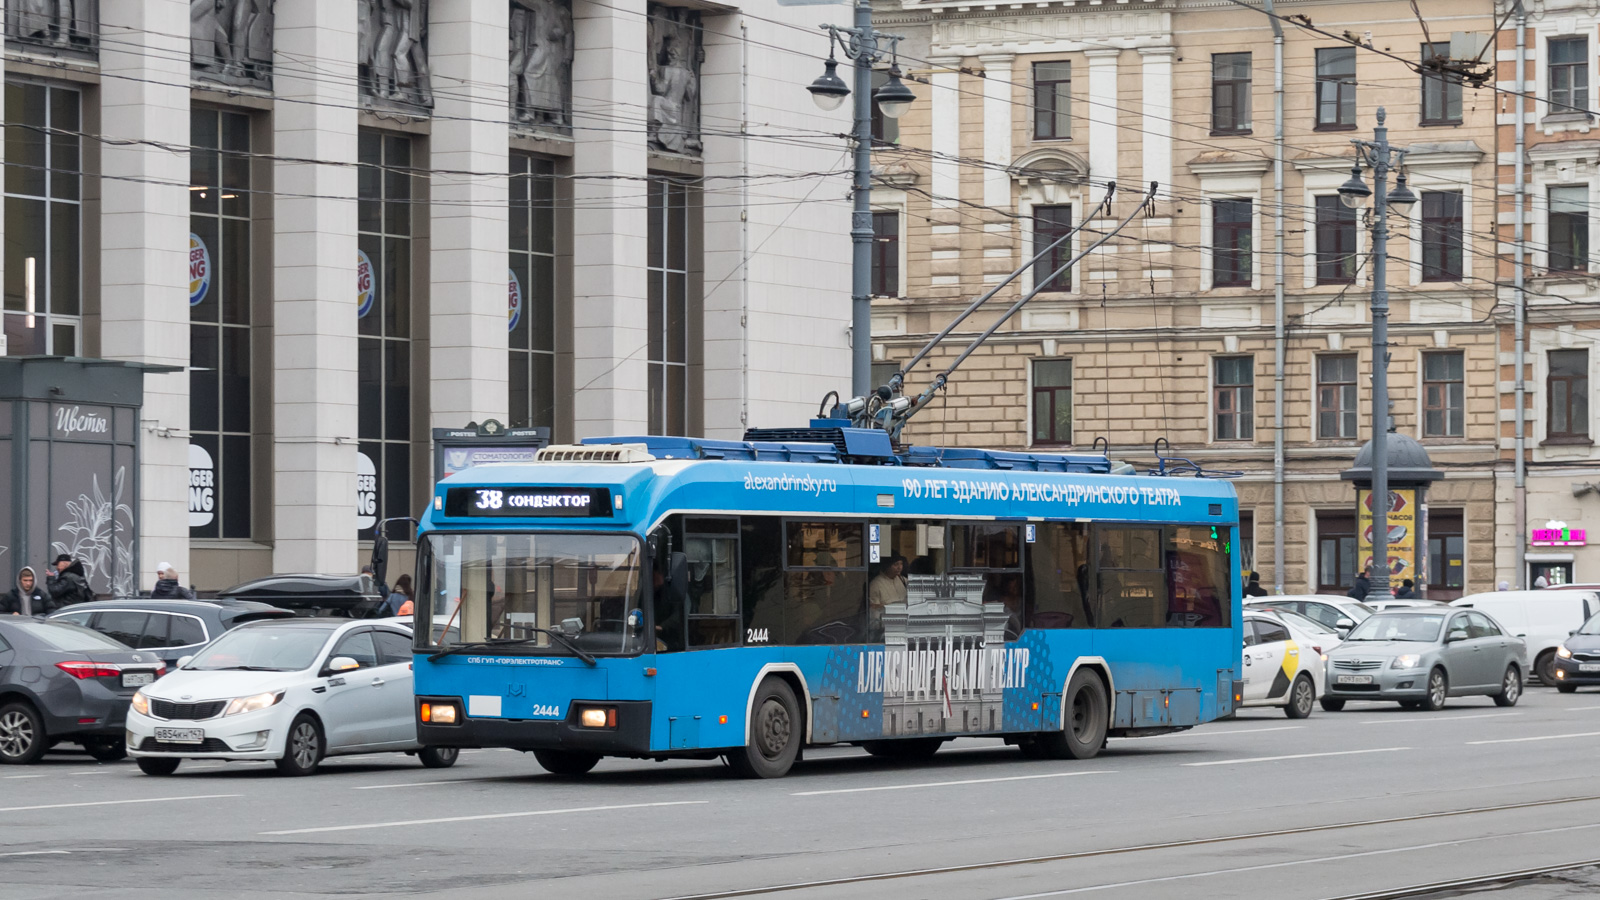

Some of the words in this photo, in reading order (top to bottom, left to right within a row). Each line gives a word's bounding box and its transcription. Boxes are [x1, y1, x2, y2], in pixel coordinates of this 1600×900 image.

[55, 405, 109, 437] Цветы
[472, 452, 533, 460] СТОМАТОЛОГИЯ
[743, 471, 837, 497] alexandrinsky.ru
[902, 478, 921, 498] 190
[924, 480, 948, 499] ЛЕТ
[951, 480, 1010, 503] ЗДАНИЮ
[1012, 482, 1140, 507] АЛЕКСАНДРИНСКОГО
[1139, 487, 1182, 506] ТЕАТРА
[475, 489, 503, 509] 38
[746, 627, 769, 643] 2444
[990, 648, 1030, 689] ТЕАТР
[533, 703, 560, 717] 2444
